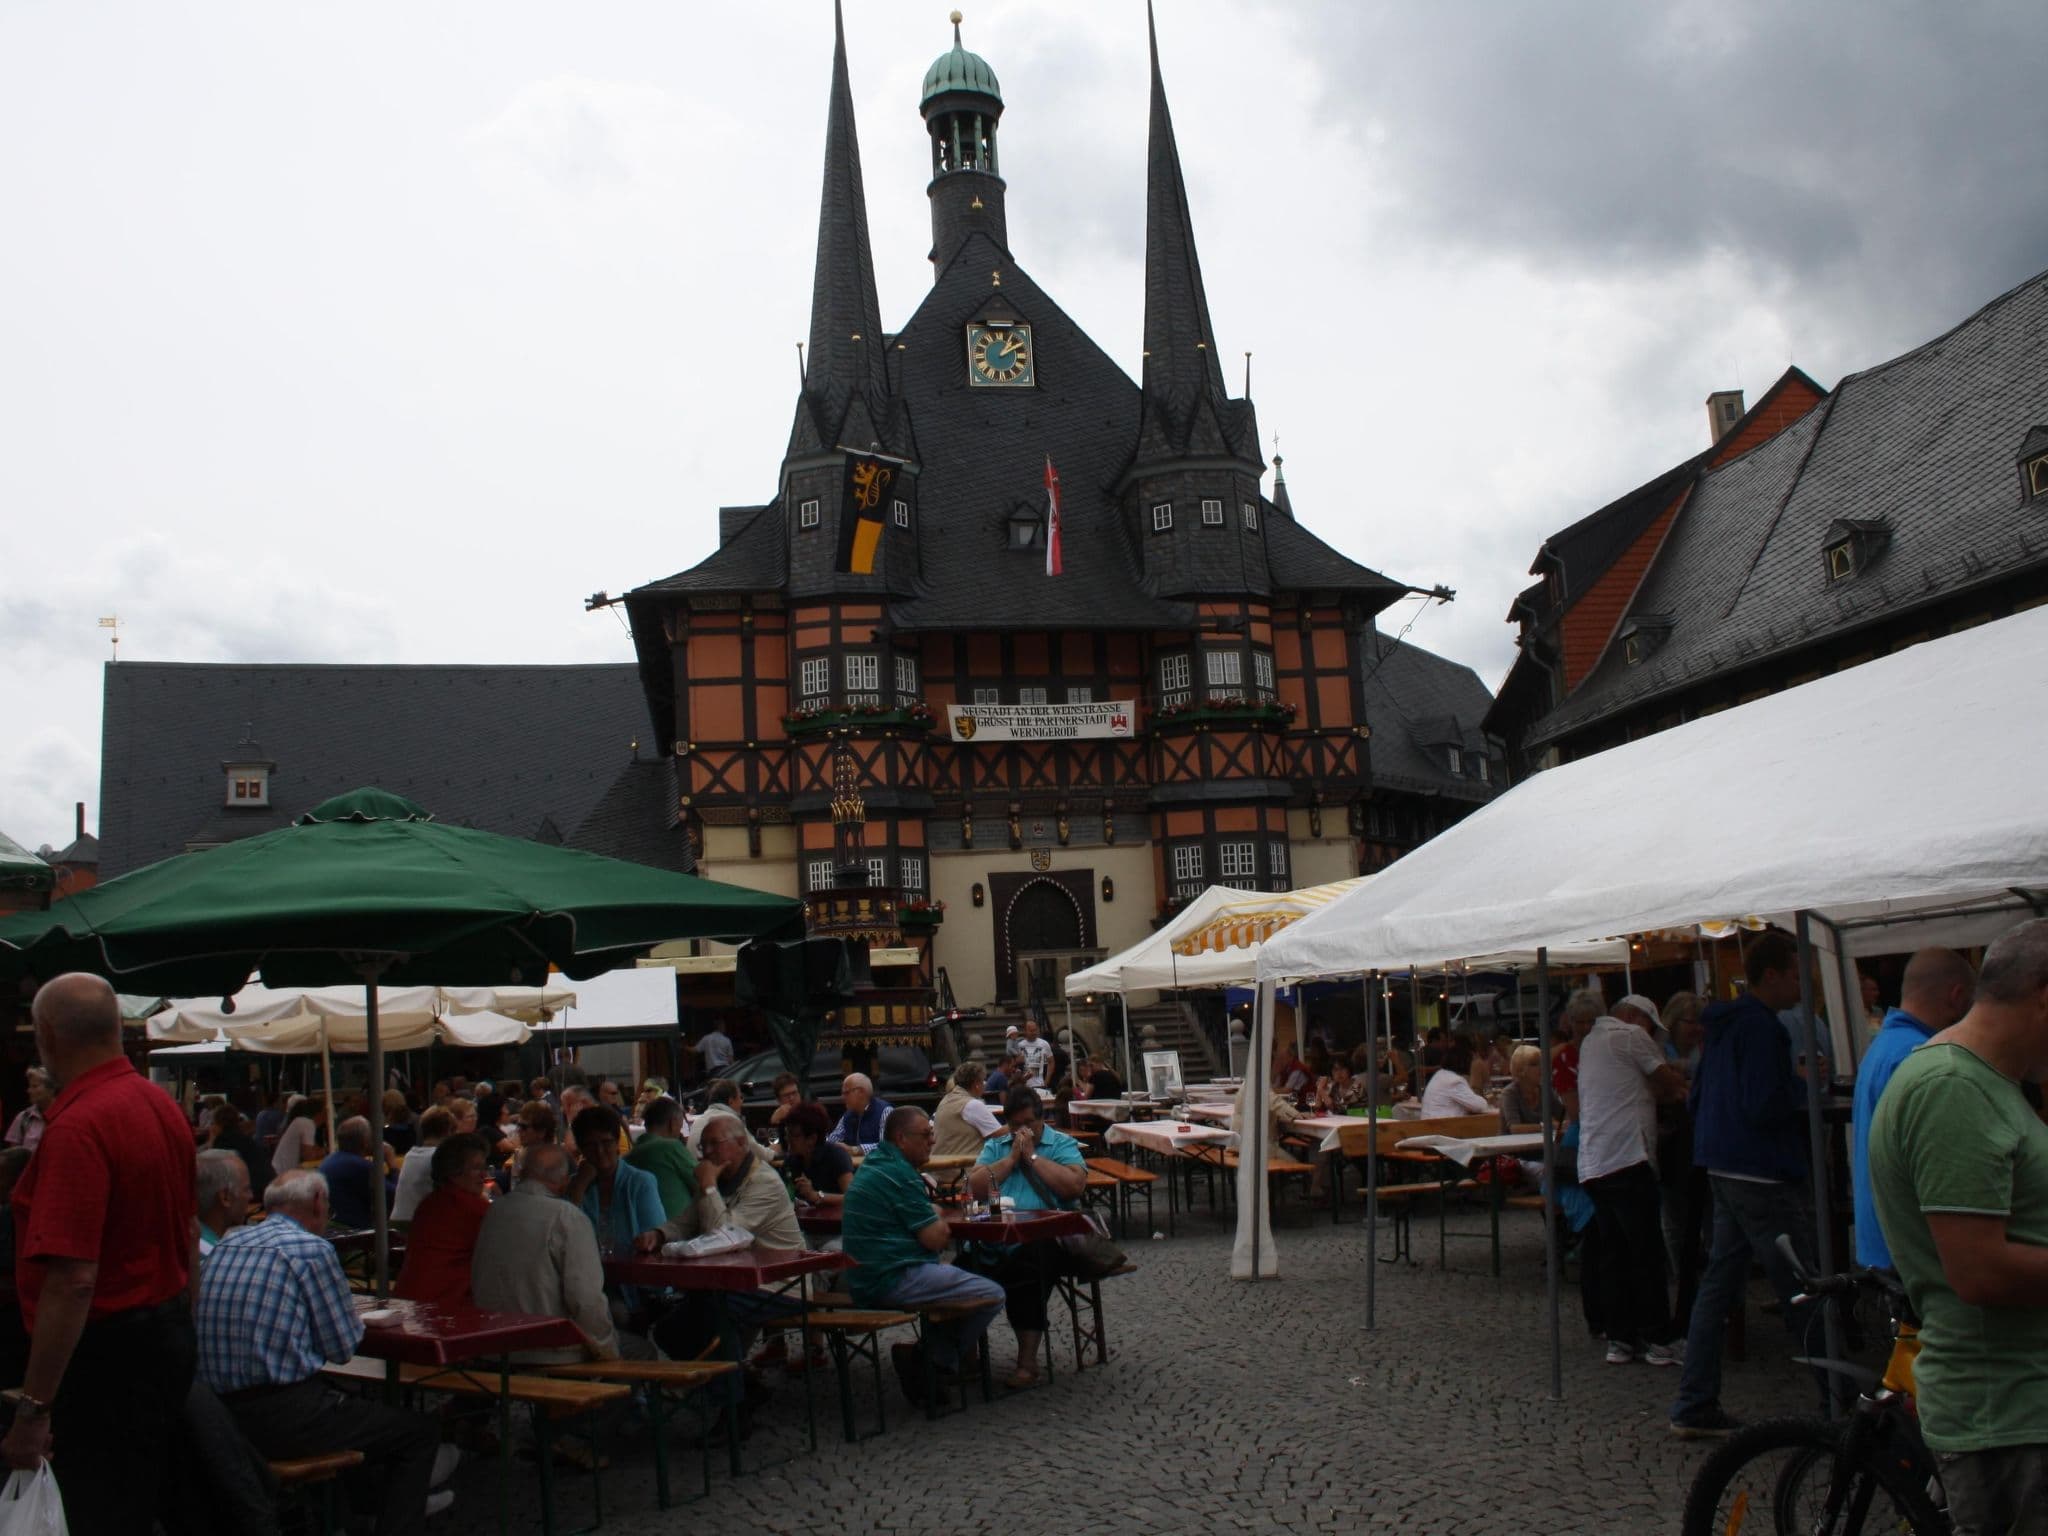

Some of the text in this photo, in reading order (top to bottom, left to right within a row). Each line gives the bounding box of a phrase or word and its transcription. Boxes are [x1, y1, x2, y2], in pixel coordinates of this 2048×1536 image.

[962, 703, 1121, 716] NEUSTADT AN DER WEINSTRASSE
[1017, 716, 1033, 727] DIE
[1036, 714, 1107, 726] PARTNERSTADT
[1010, 726, 1078, 737] WERNIGERODE
